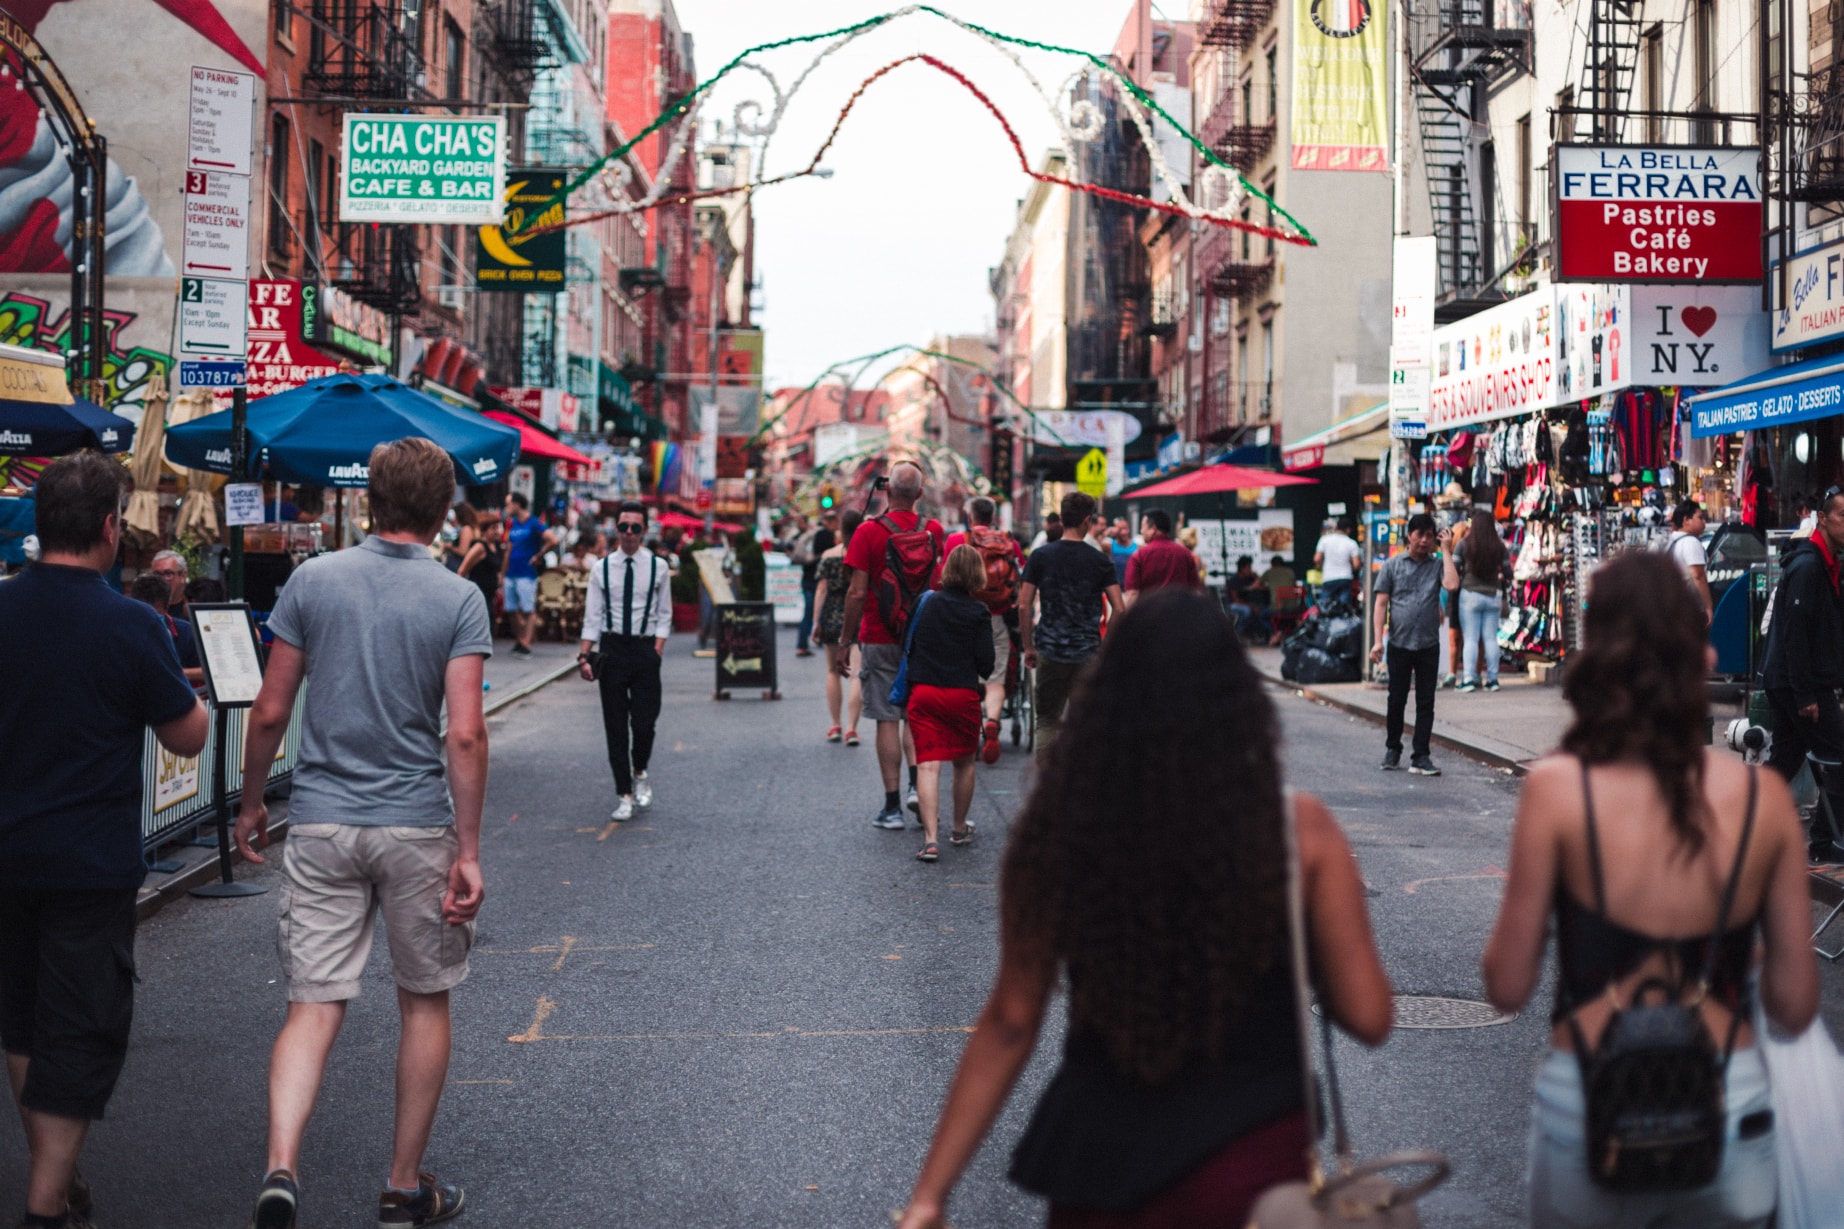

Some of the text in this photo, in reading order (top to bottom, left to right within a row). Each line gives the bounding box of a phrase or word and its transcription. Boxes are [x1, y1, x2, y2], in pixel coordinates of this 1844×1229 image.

[1297, 46, 1381, 63] WELCOME
[193, 71, 239, 85] NO PARKING
[1297, 66, 1318, 80] TO
[193, 85, 204, 93] May
[1297, 84, 1376, 100] HISTORIC
[1296, 104, 1357, 121] LITTLE
[352, 122, 495, 157] CHA CHA'S
[1296, 123, 1345, 141] ITALY
[351, 158, 494, 177] BACKYARD GARDEN
[1641, 152, 1718, 170] BELLA
[190, 172, 202, 192] 3
[350, 178, 491, 198] CAFE & BAR
[1563, 172, 1756, 199] FERRARA
[187, 201, 240, 216] COMMERCIAL
[350, 202, 389, 212] PIZZERIA
[400, 202, 438, 212] GELATO
[1603, 203, 1716, 226] Pastries
[187, 214, 245, 228] VEHICLES ONLY
[187, 239, 230, 251] Except Sunday
[1630, 227, 1692, 249] Café
[1613, 251, 1709, 278] Bakery
[187, 280, 198, 300] 2
[1794, 263, 1819, 311] Bella
[184, 318, 230, 330] Except Sunday
[1655, 305, 1674, 336] I
[1800, 308, 1837, 334] ITALIAN
[182, 370, 230, 384] 103787
[1425, 386, 1448, 424] IFTS
[1459, 367, 1517, 418] SOUVENIRS
[1520, 357, 1551, 404] SHOP
[1697, 385, 1841, 428] ITALIAN PASTRIES GELATO DESSERTS
[205, 448, 232, 464] LAVA
[1377, 522, 1389, 541] P
